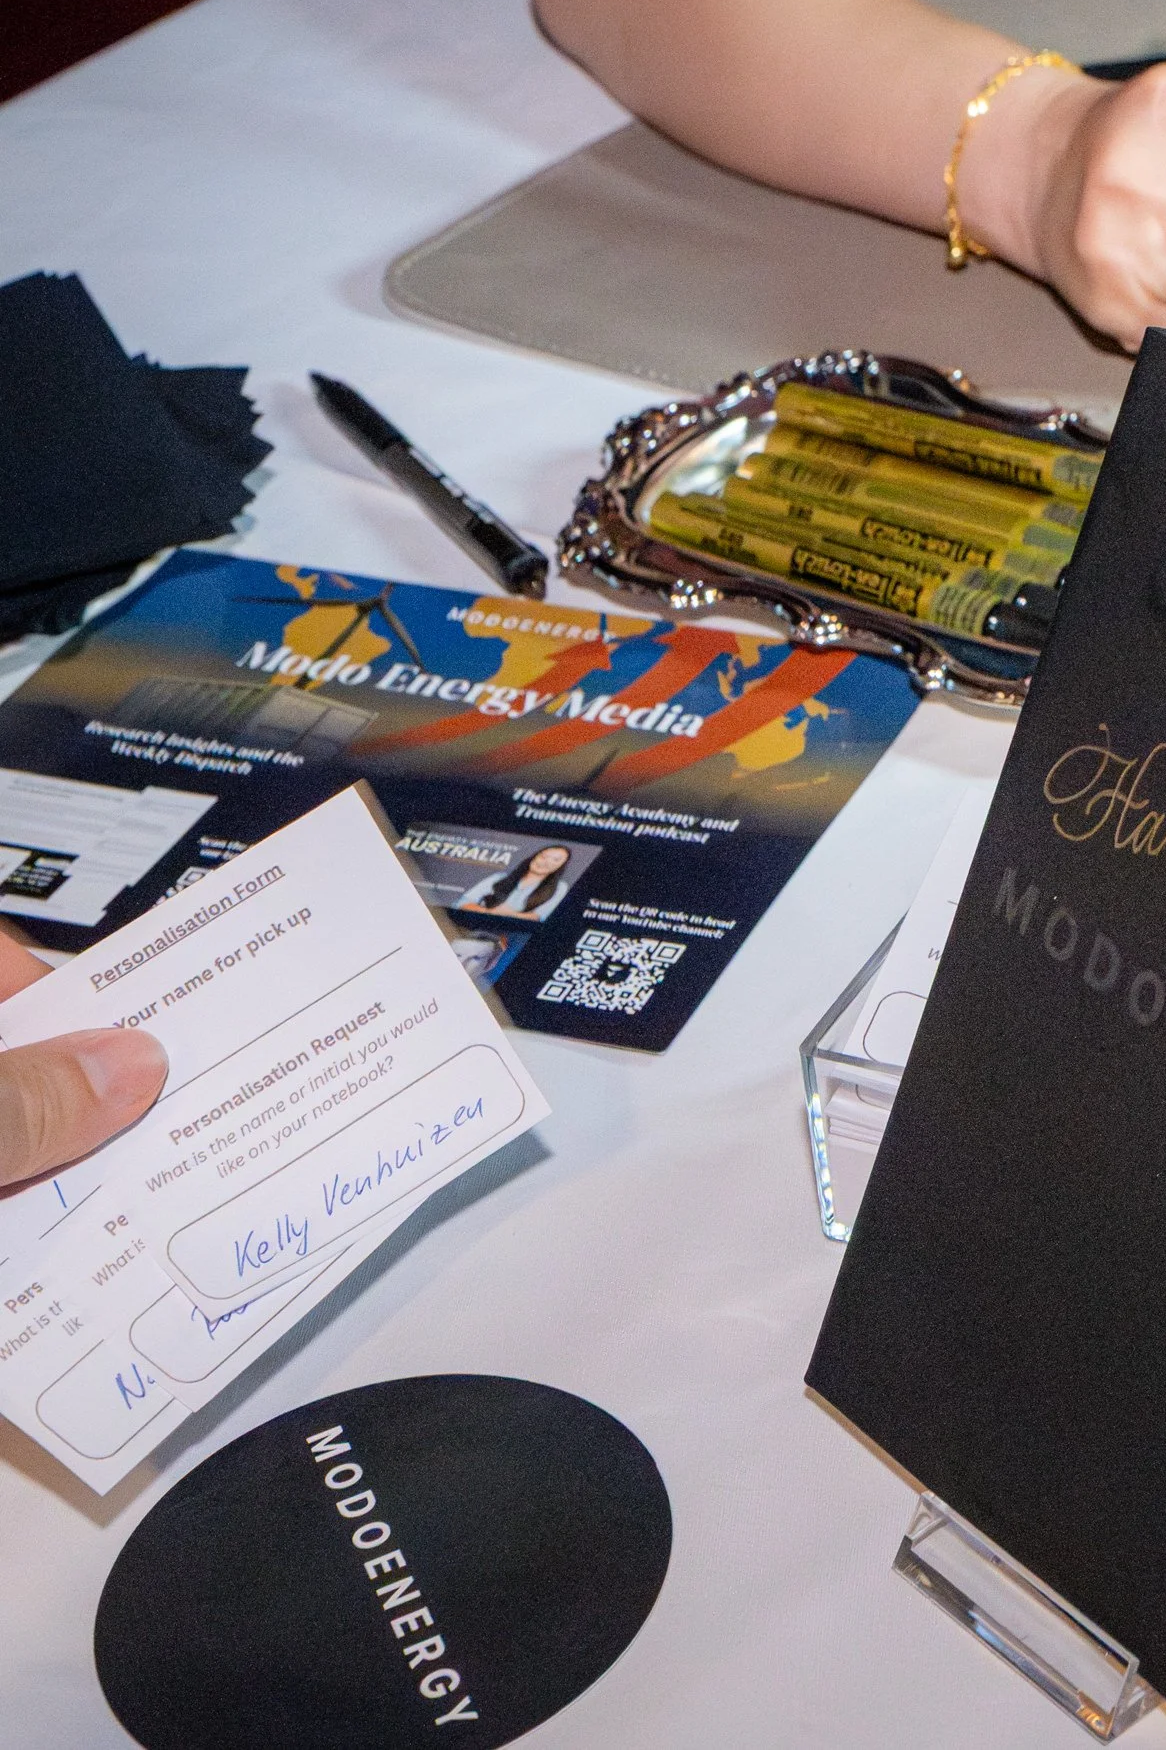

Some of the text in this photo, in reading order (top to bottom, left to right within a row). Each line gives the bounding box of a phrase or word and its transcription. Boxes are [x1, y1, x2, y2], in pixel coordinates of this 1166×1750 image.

[235, 641, 705, 738] Modo Energy Media
[394, 836, 512, 866] AUSTRALIA
[512, 787, 740, 833] The Energy Academy and
[515, 805, 711, 845] Transmission podcast
[89, 865, 285, 991] Personalisation Form
[113, 906, 312, 1030] Your name for pick up
[145, 997, 439, 1193] What is the name or initial you would
[169, 1000, 386, 1146] Personalisation Request
[215, 1054, 396, 1179] like on your notebook?
[92, 1247, 136, 1287] What
[235, 1213, 308, 1277] Kelly
[33, 1313, 51, 1330] is
[305, 1424, 479, 1727] MODOENERGY
